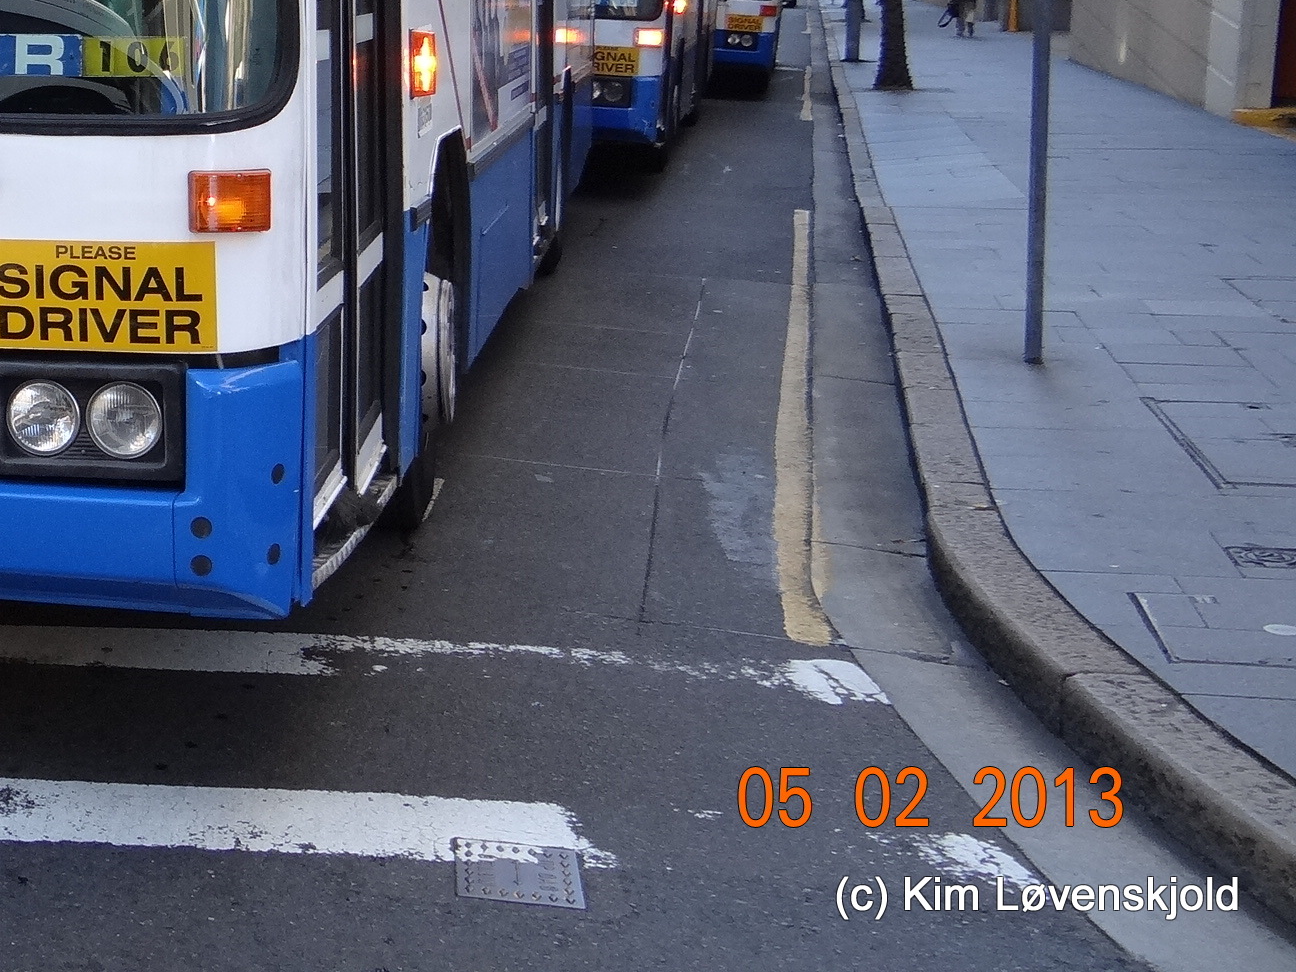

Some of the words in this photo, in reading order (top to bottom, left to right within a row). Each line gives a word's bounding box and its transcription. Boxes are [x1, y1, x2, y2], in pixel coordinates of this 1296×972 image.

[15, 34, 65, 76] R
[99, 41, 180, 74] 106
[594, 51, 636, 63] GNAL
[594, 62, 635, 73] RIVER
[55, 244, 137, 260] PLEASE
